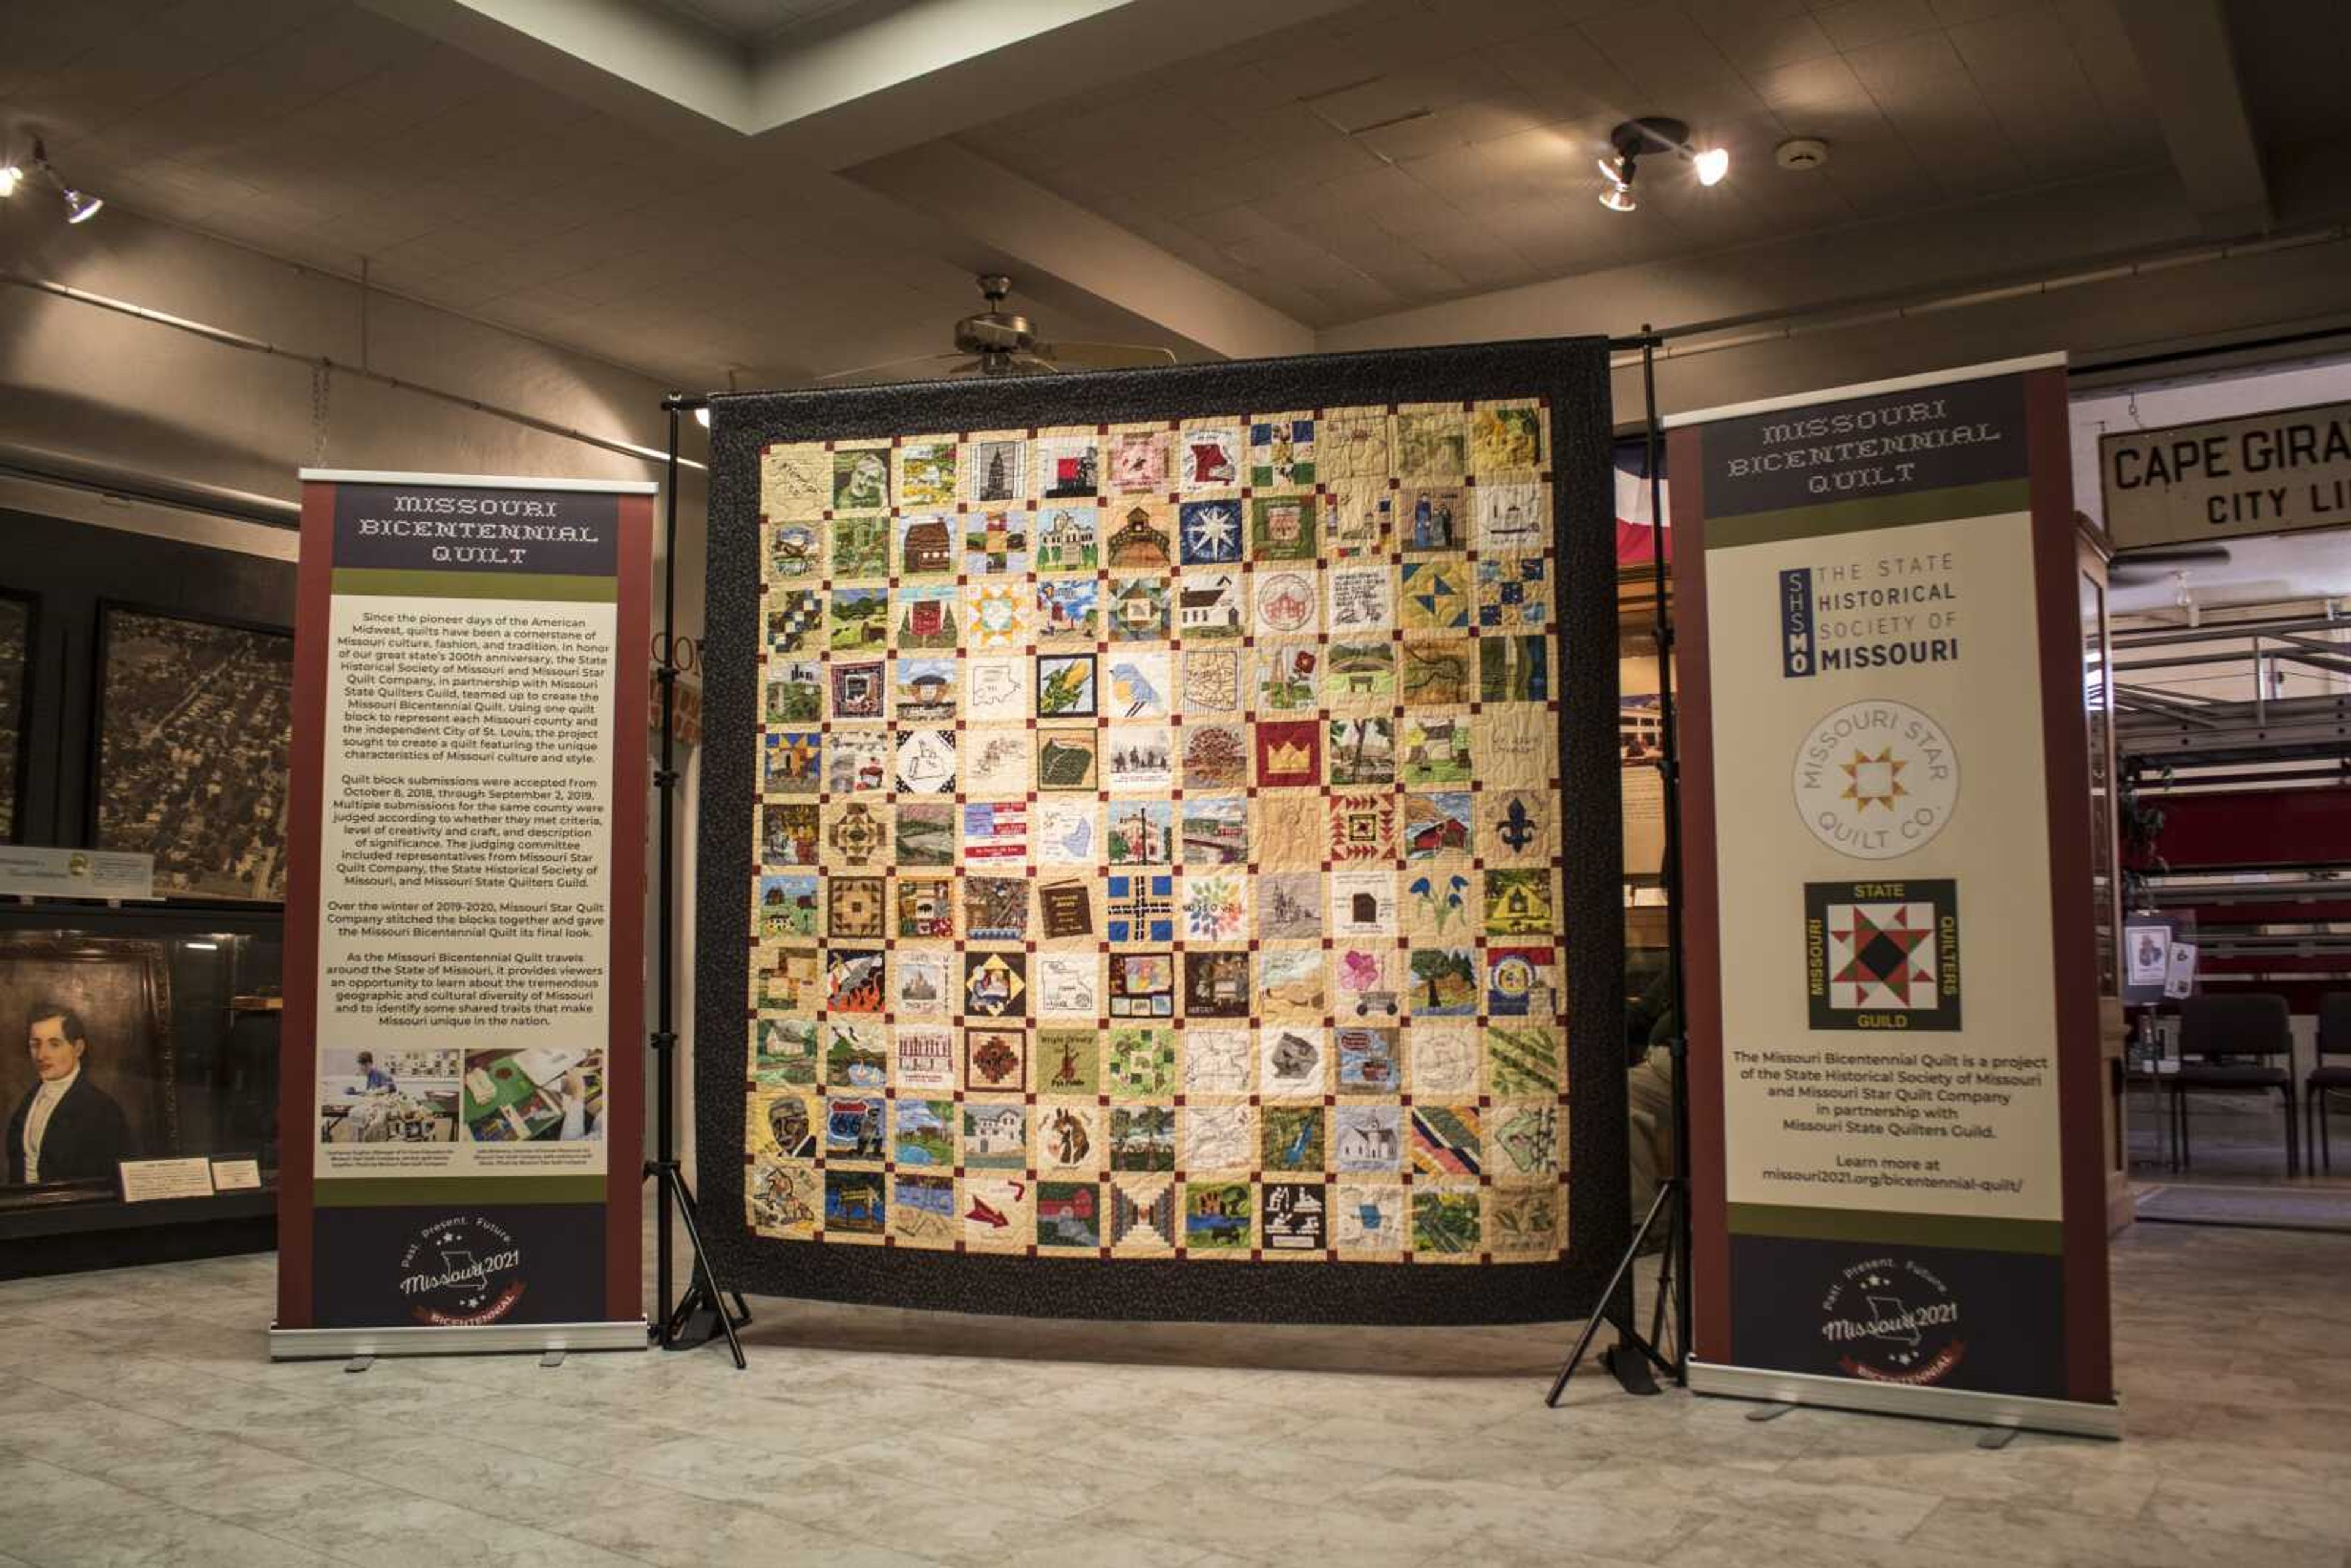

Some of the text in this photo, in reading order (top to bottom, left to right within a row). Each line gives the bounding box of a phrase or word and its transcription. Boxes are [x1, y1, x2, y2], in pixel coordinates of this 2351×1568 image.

[1763, 399, 1948, 445] MISSOURI
[1728, 423, 2001, 478] BICENTENNIAL
[2115, 420, 2351, 489] CAPE GIRA
[1808, 462, 1916, 493] QUILT
[394, 495, 558, 517] MISSOURI
[2207, 479, 2351, 525] CITY LI
[359, 519, 599, 542] BICENTENNIAL
[432, 546, 527, 564] QUILT
[1817, 552, 1953, 582] THE STATE
[1818, 582, 1957, 612] HISTORICAL
[362, 613, 585, 628] Since the pioneer days of the American
[1820, 611, 1957, 640] SOCIETY OF
[352, 625, 405, 637] Midwest,
[405, 627, 439, 639] quilts
[441, 628, 470, 637] have
[470, 628, 501, 638] been
[513, 630, 582, 640] cornerstone
[584, 632, 596, 640] of
[1821, 638, 1958, 671] MISSOURI
[1804, 709, 1948, 789] MISSOURI STAR
[343, 788, 392, 798] October
[406, 790, 435, 800] 2018,
[437, 790, 486, 801] through
[488, 791, 552, 802] September
[566, 792, 594, 801] 2019.
[1818, 811, 1889, 849] QUILT
[1854, 883, 1905, 898] STATE
[327, 902, 604, 913] Over the winter of 2019-2020, Missouri Star Quilt
[327, 915, 605, 927] Company stitched the blocks together and gave
[337, 928, 593, 939] the Missouri Bicentennial Quilt its final look.
[347, 953, 584, 964] As the Missouri Bicentennial Quilt travels
[1809, 918, 1824, 996] MISSOURI
[1941, 916, 1958, 996] QUILTERS
[326, 966, 603, 977] around the State of Missouri, it provides viewers
[348, 979, 420, 990] opportunity
[421, 978, 435, 988] to
[435, 979, 466, 988] learn
[468, 979, 503, 988] about
[504, 979, 525, 988] the
[528, 980, 599, 989] tremendous
[335, 991, 593, 1003] geographic and cultural diversity of Missouri
[335, 1004, 358, 1013] and
[359, 1004, 373, 1013] to
[376, 1005, 421, 1016] identify
[458, 1005, 498, 1014] shared
[501, 1005, 531, 1013] traits
[534, 1005, 558, 1013] that
[561, 1004, 593, 1013] make
[378, 1016, 550, 1028] Missouri unique in the nation.
[1857, 1014, 1908, 1028] GUILD
[1732, 1052, 1760, 1063] The
[1762, 1053, 1821, 1064] Missouri
[1823, 1054, 1918, 1066] Bicentennial
[1920, 1055, 1959, 1068] Quilt
[1962, 1056, 1975, 1068] is
[1992, 1056, 2048, 1071] project
[1739, 1069, 2041, 1087] of the State Historical Society of Missouri
[1766, 1086, 2011, 1106] and Missouri Star Quilt Company
[1816, 1104, 1959, 1121] in partnership with
[1783, 1120, 1996, 1139] Missouri State Quilters Guild.
[1836, 1156, 1940, 1171] Learn more at
[1762, 1169, 2023, 1195] missouri2021.org/bicentennial-quilt/
